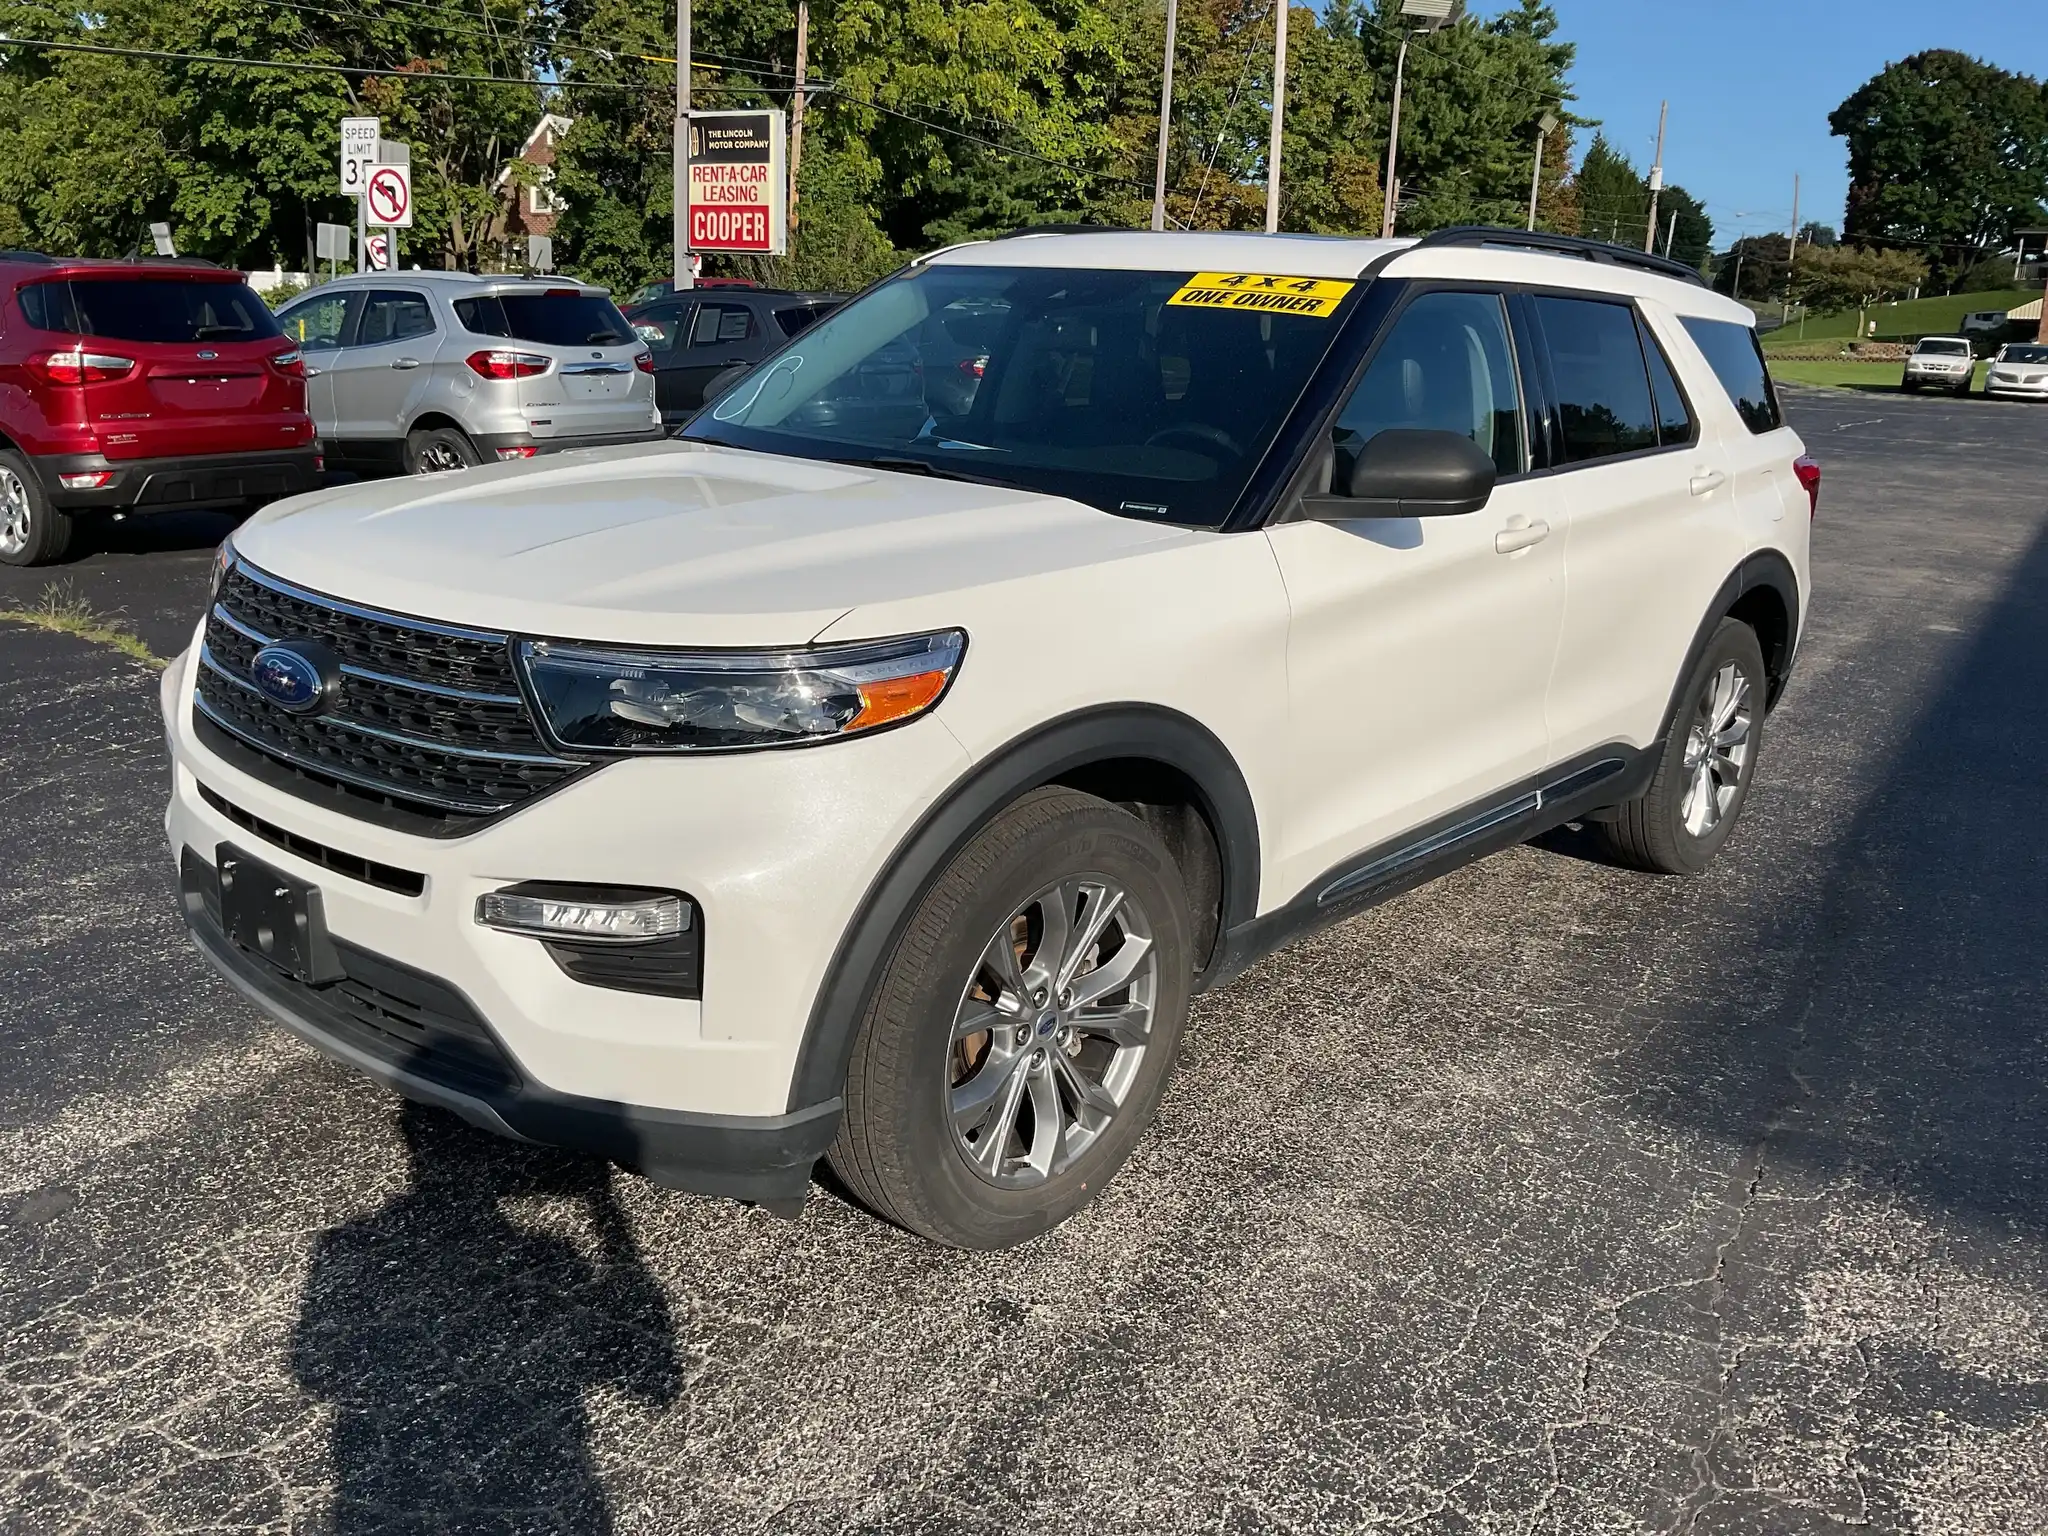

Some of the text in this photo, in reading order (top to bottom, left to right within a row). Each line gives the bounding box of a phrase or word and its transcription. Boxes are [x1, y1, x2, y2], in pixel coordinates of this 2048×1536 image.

[345, 128, 375, 139] SPEED
[708, 129, 753, 138] THE LINCOLN
[348, 143, 372, 155] LIMIT
[708, 140, 769, 149] MOTOR COMPANY
[693, 165, 767, 183] RENT-A-CAR
[703, 185, 758, 203] LEASING
[694, 211, 765, 242] COOPER
[1181, 290, 1325, 312] ONE OWNER
